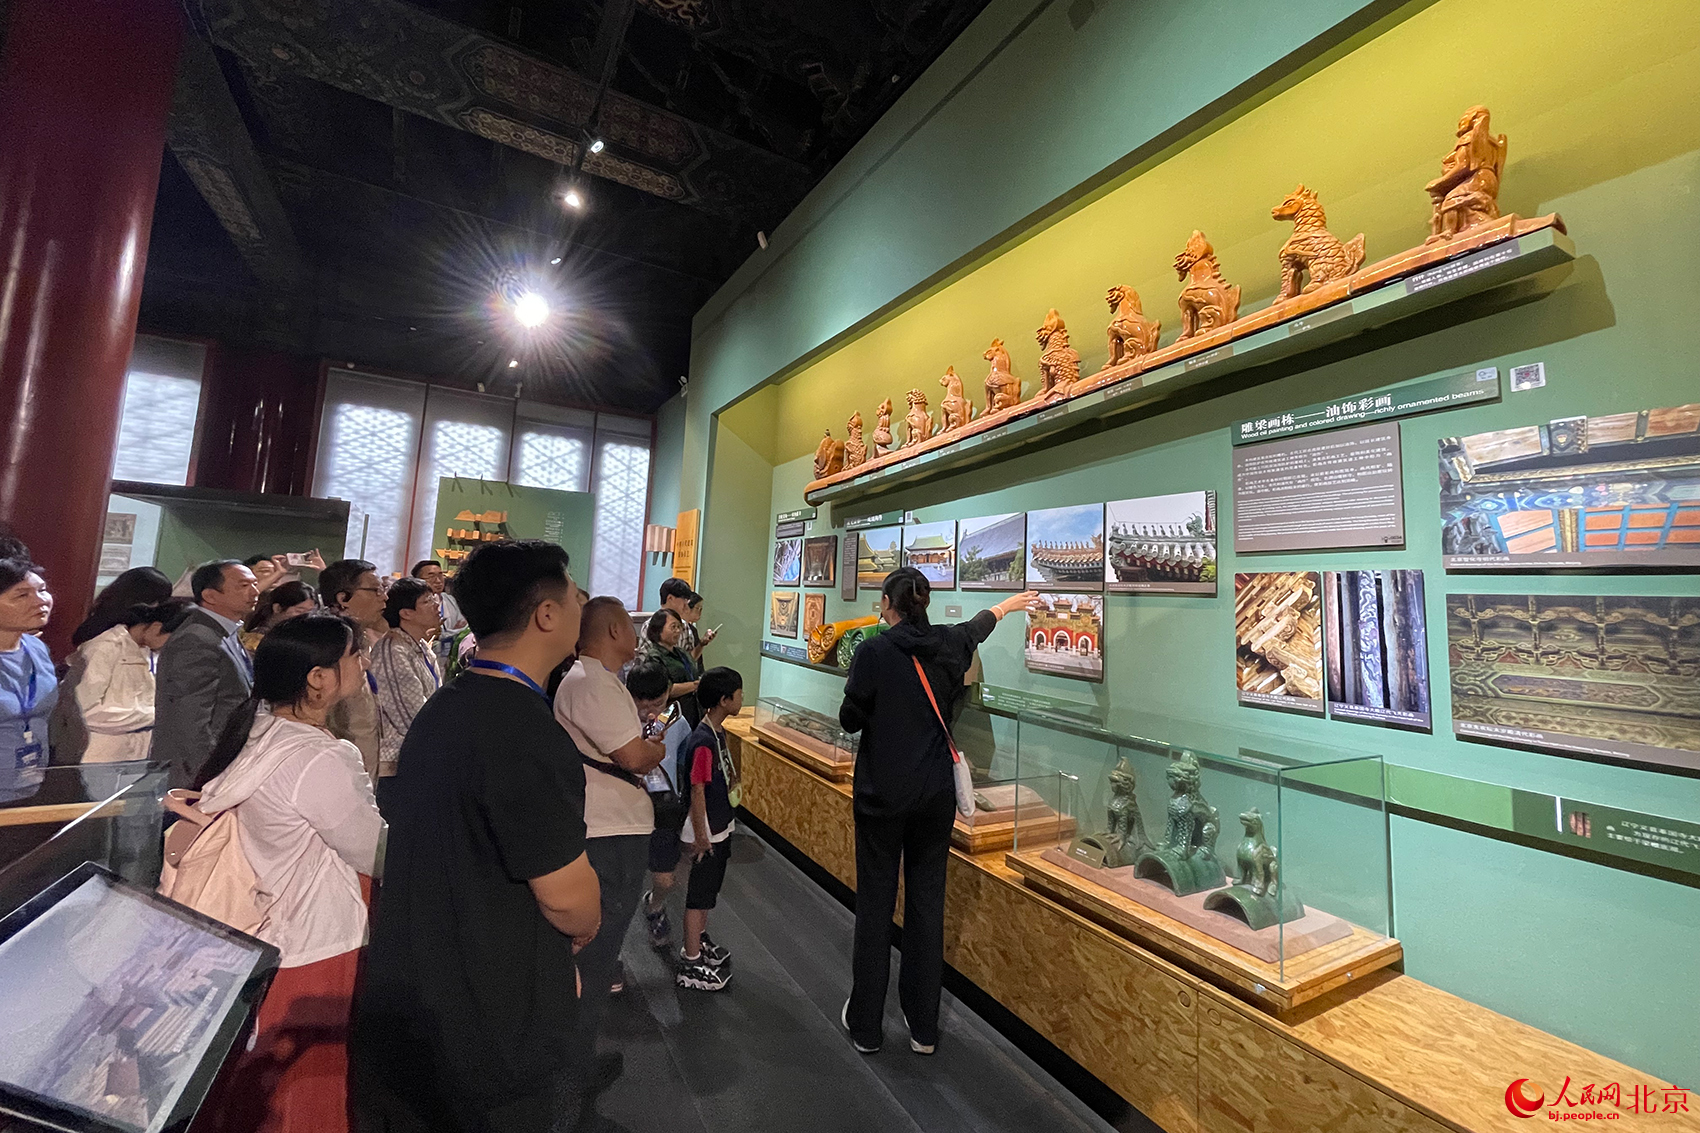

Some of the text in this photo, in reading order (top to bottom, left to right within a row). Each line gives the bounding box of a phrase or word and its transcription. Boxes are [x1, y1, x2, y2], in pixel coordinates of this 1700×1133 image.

[1241, 431, 1259, 439] Wood
[1268, 425, 1294, 435] painting
[1294, 422, 1308, 430] and
[1308, 417, 1335, 427] colored
[1397, 394, 1450, 410] ornamented
[1451, 389, 1485, 400] beams
